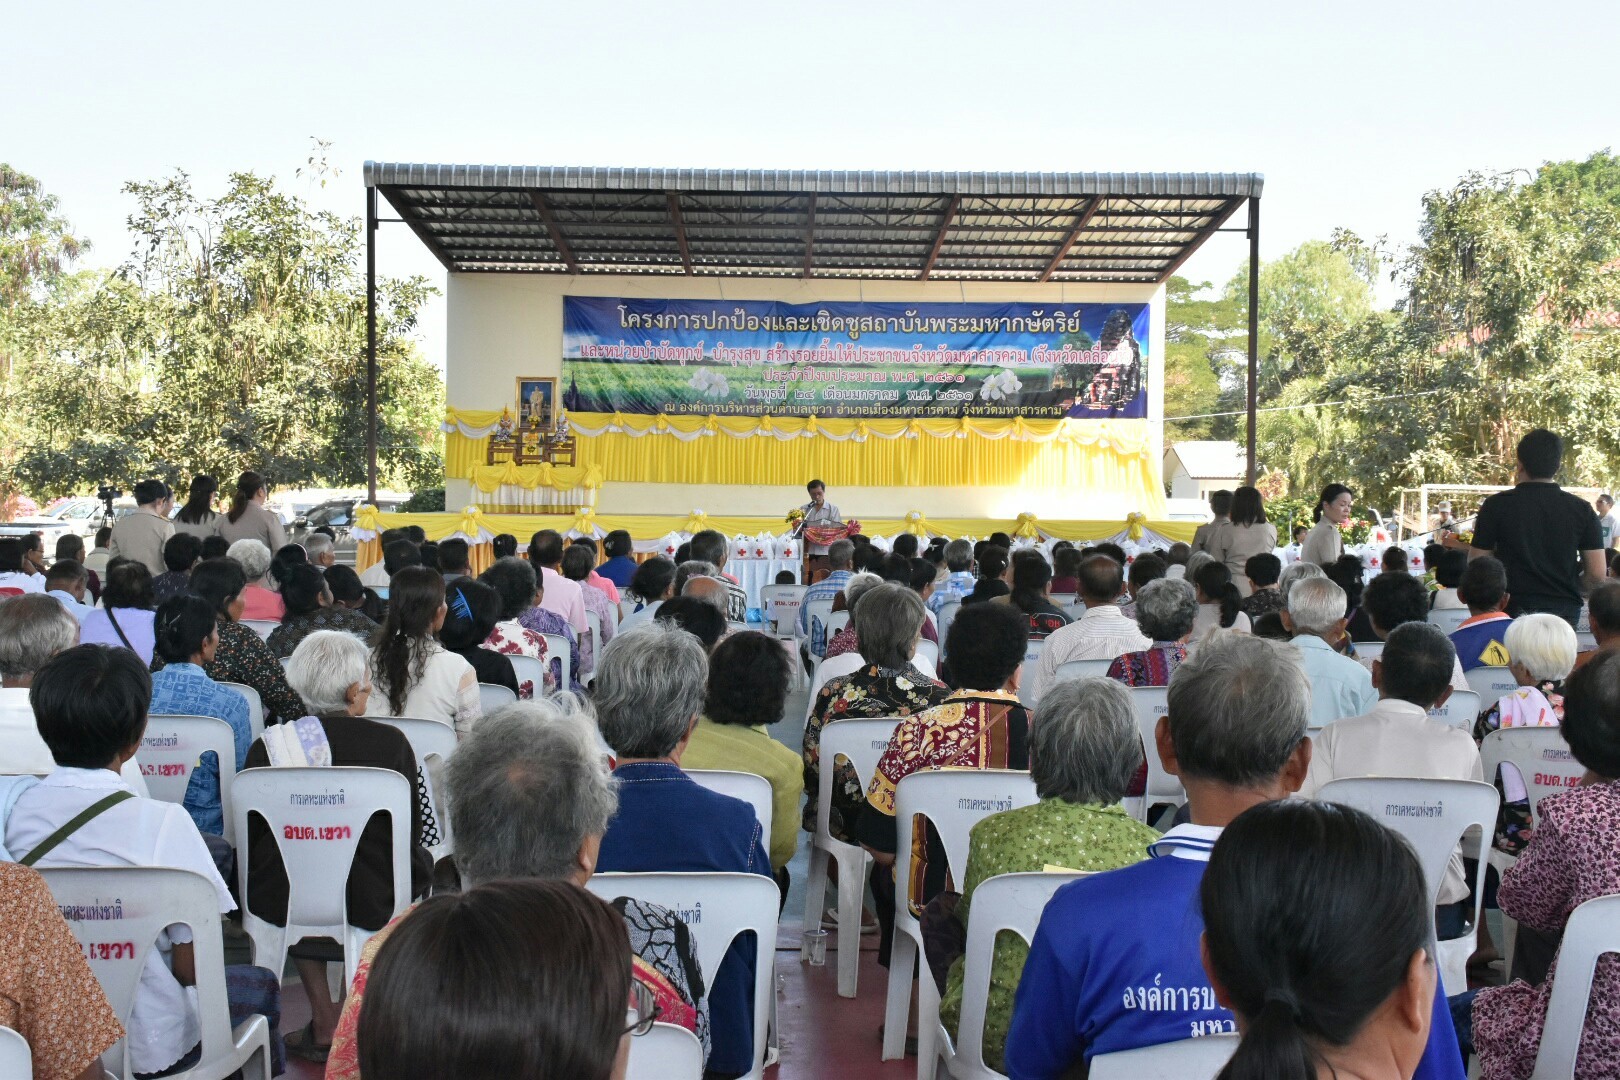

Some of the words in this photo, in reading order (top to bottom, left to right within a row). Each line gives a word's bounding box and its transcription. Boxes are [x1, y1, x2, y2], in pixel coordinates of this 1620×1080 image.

[617, 305, 1081, 341] โครงการปกป้องและเชิดชูสถาบันพระมหากษัตริย์
[580, 340, 704, 366] และหน่วยบำบัดทุกข์
[712, 341, 761, 367] บำรุงสุข
[766, 338, 1027, 364] สร้างรอยยิ้มให้ประชาชนจังหวัดมหาสารคาม
[763, 366, 887, 382] ประจำปีงบประมาณ
[891, 371, 920, 383] พ.ศ.
[924, 372, 966, 383] ๒๕๖๑
[744, 382, 787, 403] วันพุธที่
[823, 385, 899, 400] เดือนมกราคม
[906, 389, 933, 400] พ.ศ.
[664, 403, 676, 412] ณ
[680, 400, 832, 415] องค์การบริหารส่วนตำบลเขวา
[836, 402, 959, 416] อำเภอเมืองมหาสารคาม
[962, 403, 1062, 416] จังหวัดมหาสารคาม
[290, 788, 345, 806] การเคหะแห่งชาติ
[283, 825, 352, 840] อบต.เขวา
